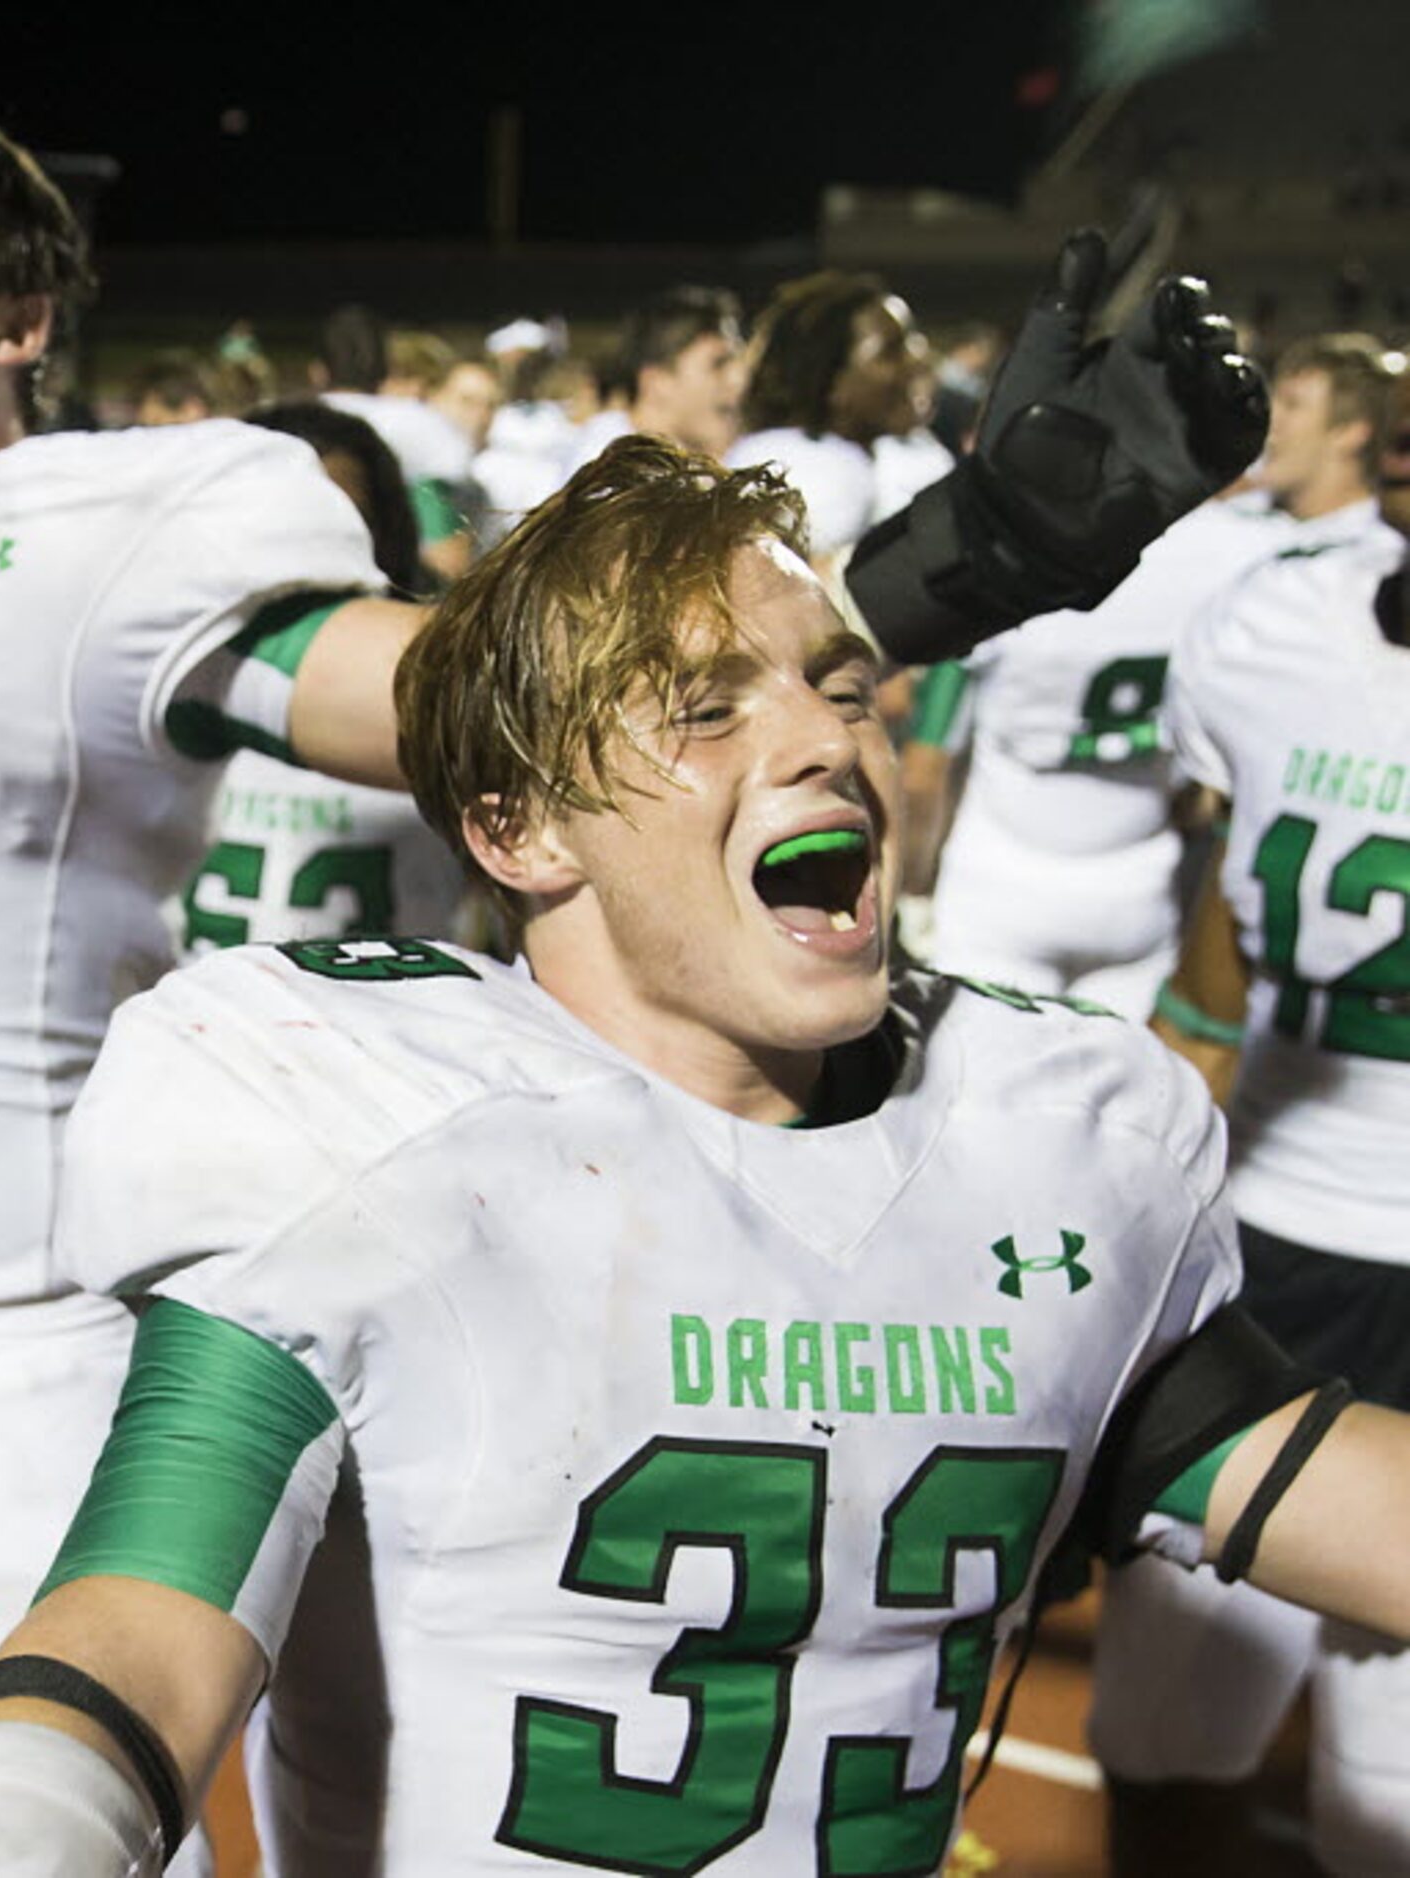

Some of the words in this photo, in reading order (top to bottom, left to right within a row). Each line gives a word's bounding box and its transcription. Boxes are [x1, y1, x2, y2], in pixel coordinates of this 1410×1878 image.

[1282, 746, 1410, 816] DRAGO
[1249, 813, 1410, 1062] 12
[670, 1312, 1018, 1416] DRAGONS
[493, 1434, 1069, 1878] 33
